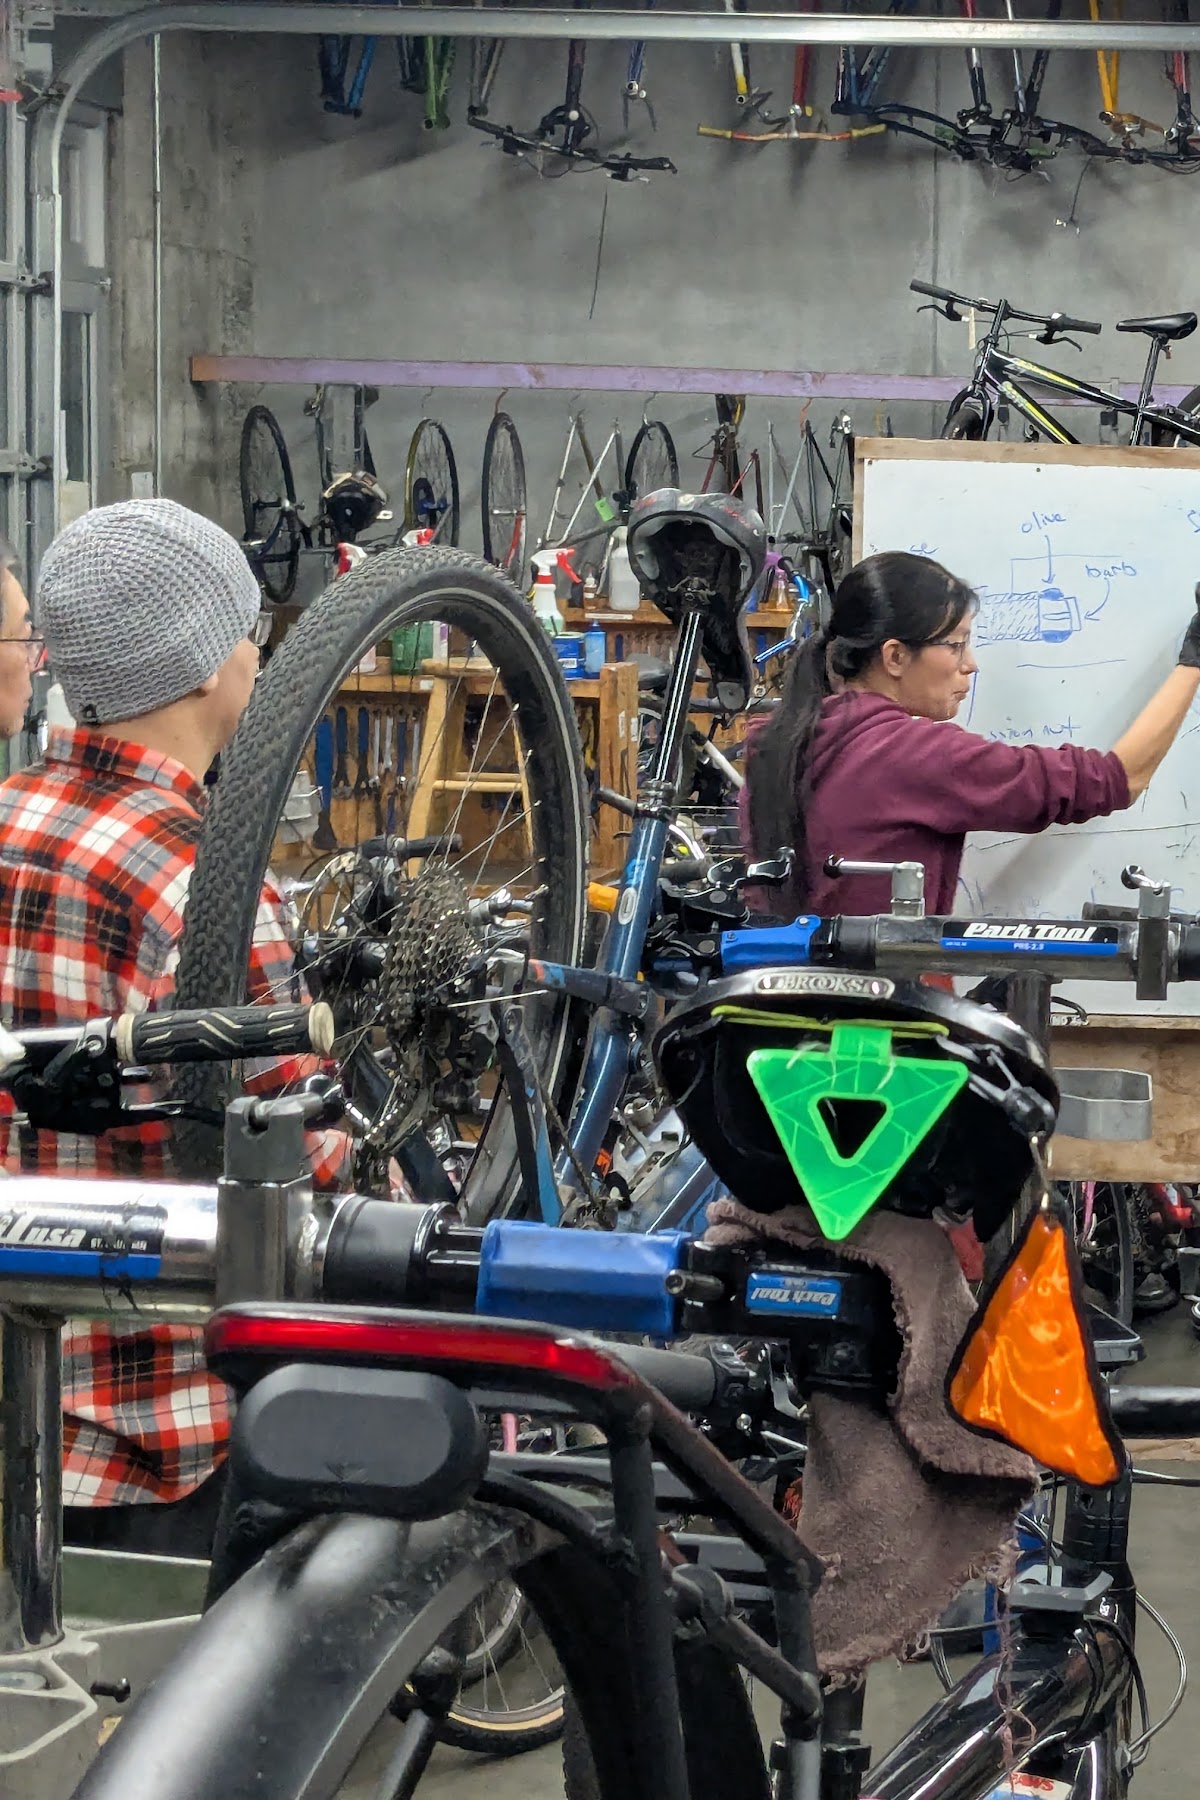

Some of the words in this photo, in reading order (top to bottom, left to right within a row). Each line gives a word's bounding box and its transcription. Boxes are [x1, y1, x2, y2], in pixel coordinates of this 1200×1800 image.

[1021, 512, 1067, 533] olive
[1085, 562, 1138, 578] barb
[963, 922, 1031, 939] Park
[1032, 924, 1098, 942] Tool
[750, 1287, 791, 1303] Tool
